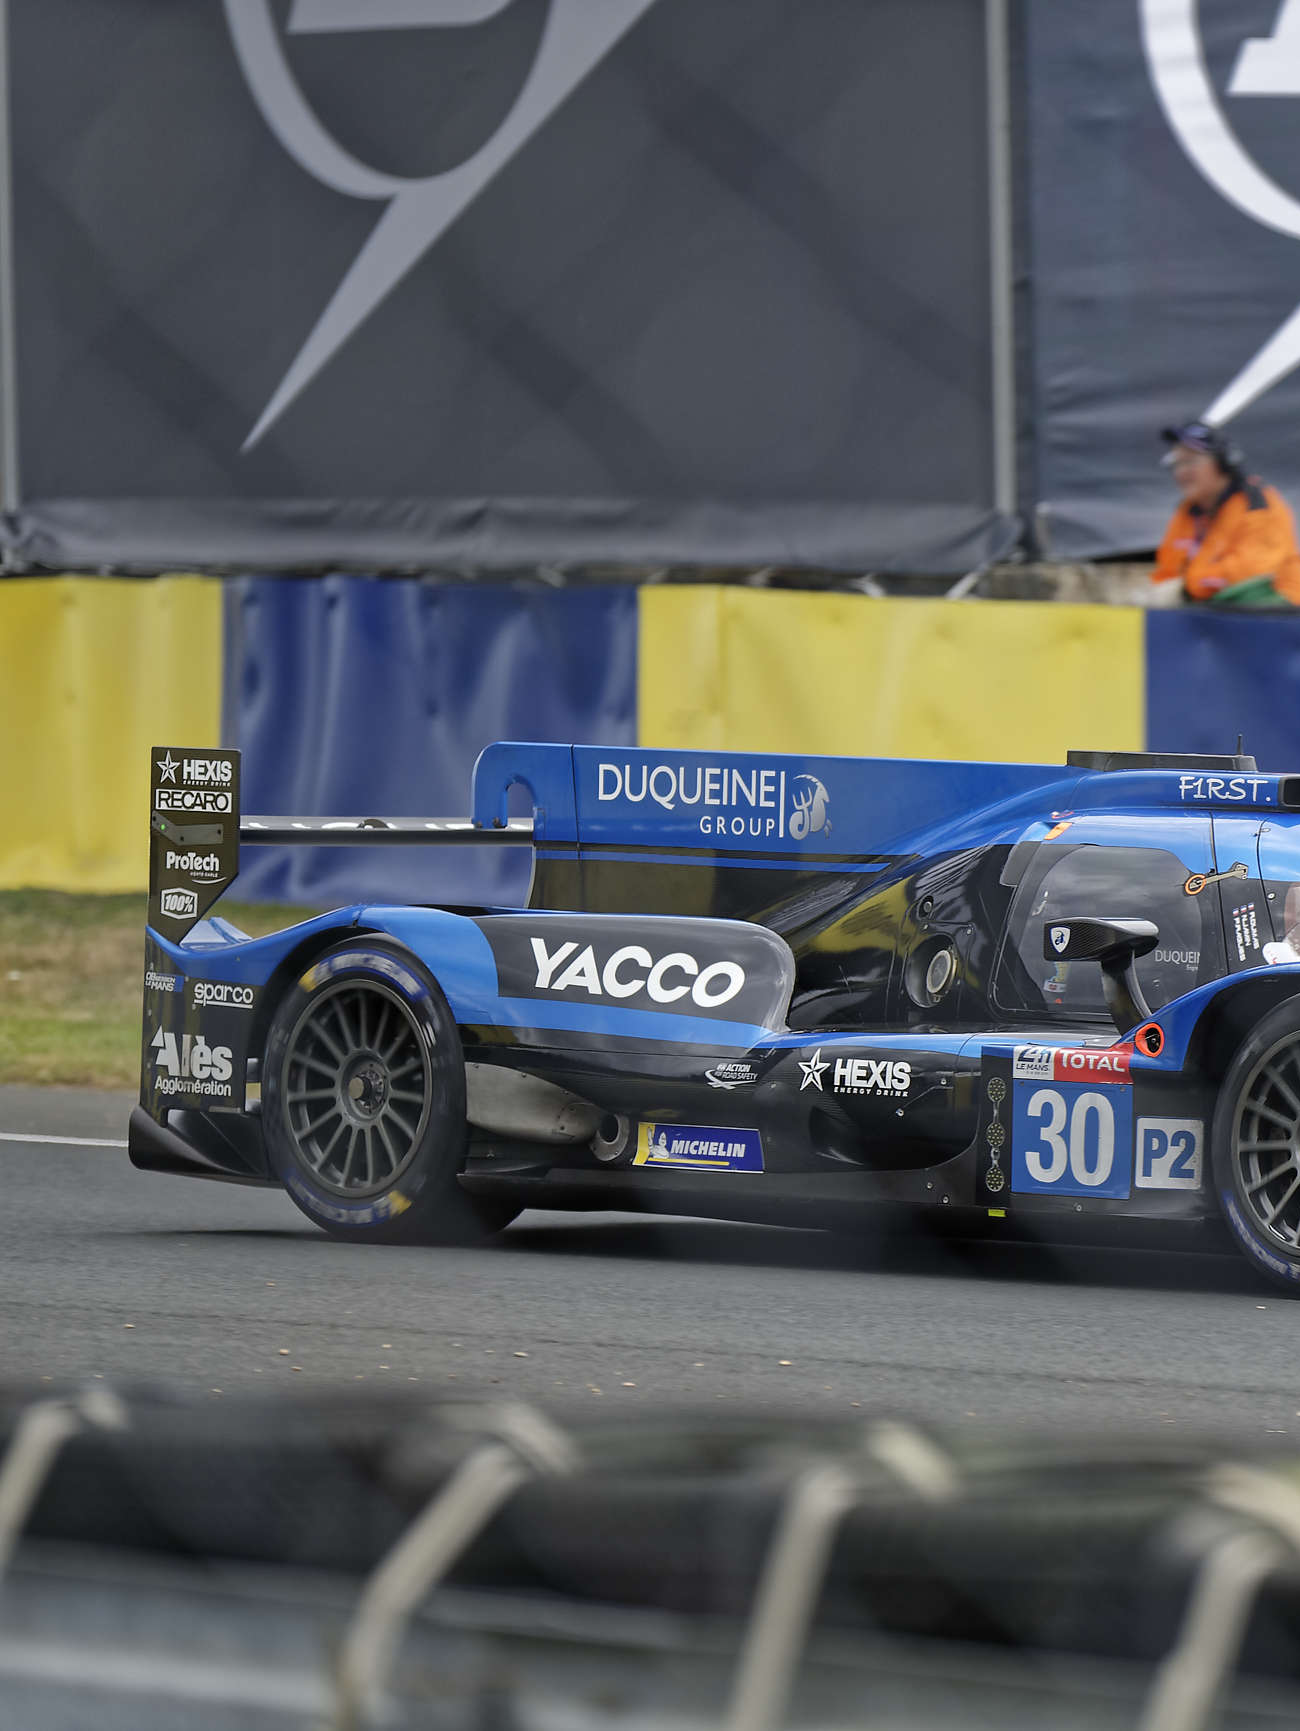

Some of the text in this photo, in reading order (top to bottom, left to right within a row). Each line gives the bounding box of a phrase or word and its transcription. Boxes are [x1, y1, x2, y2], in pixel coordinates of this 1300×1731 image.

[182, 758, 233, 783] HEXIS
[598, 763, 776, 810] DUQUEINE
[158, 790, 230, 812] RECARO
[699, 815, 776, 838] GROUP
[166, 851, 220, 872] ProTech
[164, 894, 194, 913] 100%
[529, 936, 746, 1009] YACCO
[194, 983, 254, 1008] sparco
[150, 1024, 233, 1081] Alès
[1059, 1049, 1126, 1073] TOTAL
[154, 1075, 232, 1097] Agglomération
[833, 1058, 912, 1091] HEXIS
[833, 1086, 910, 1098] ENERGY DRINK
[670, 1138, 746, 1158] MICHELIN
[1024, 1088, 1116, 1187] 30
[1141, 1127, 1197, 1180] P2
